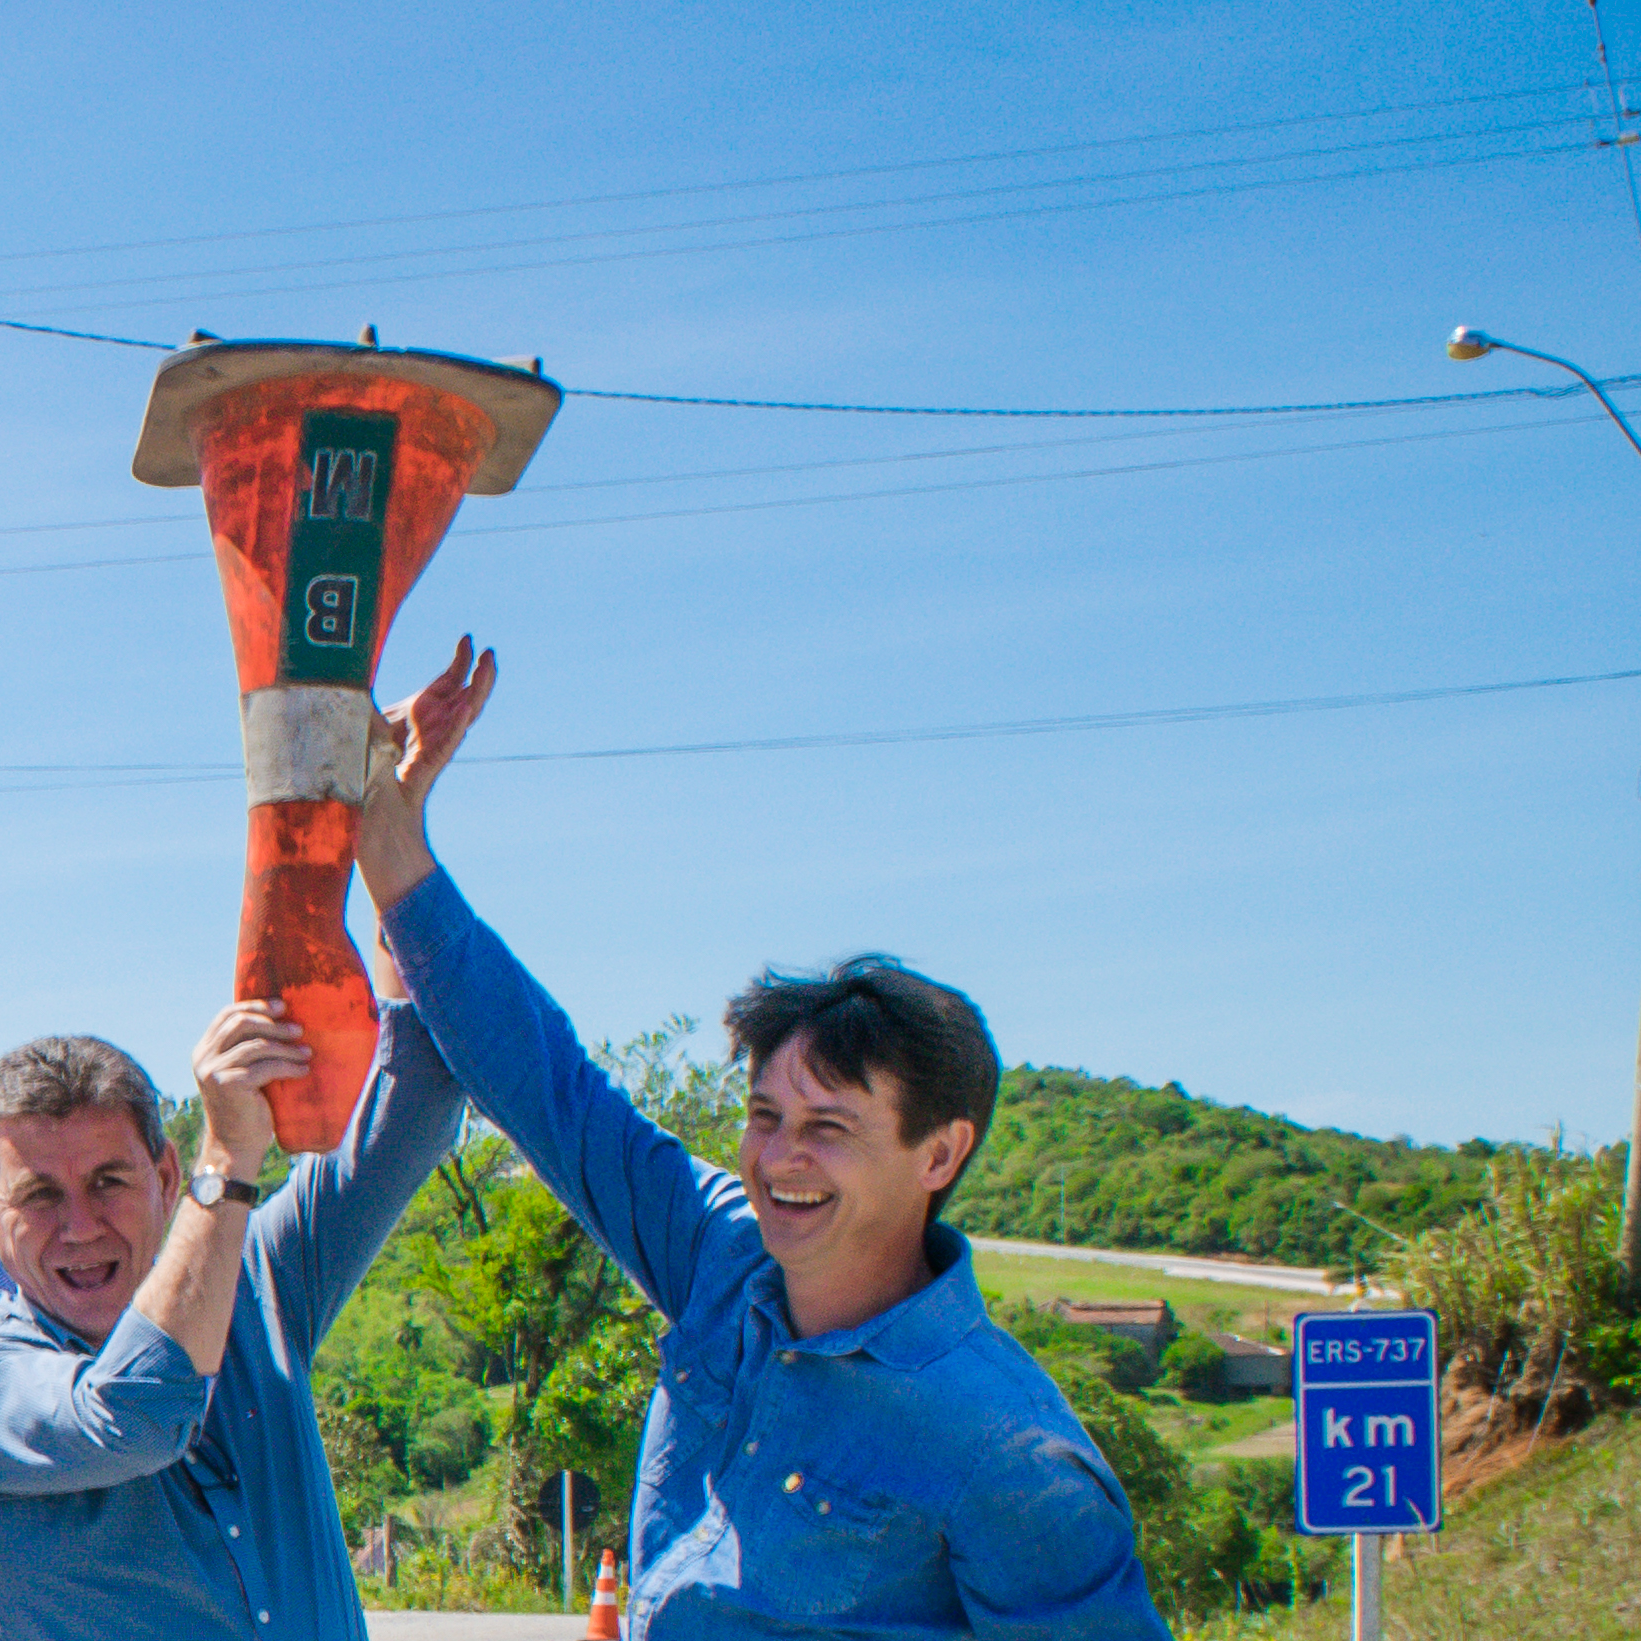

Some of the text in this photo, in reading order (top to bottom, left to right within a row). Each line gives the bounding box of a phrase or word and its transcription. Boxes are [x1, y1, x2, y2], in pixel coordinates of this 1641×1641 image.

[1307, 1337, 1426, 1364] ERS-737
[1322, 1407, 1416, 1448] km
[1342, 1464, 1397, 1508] 21
